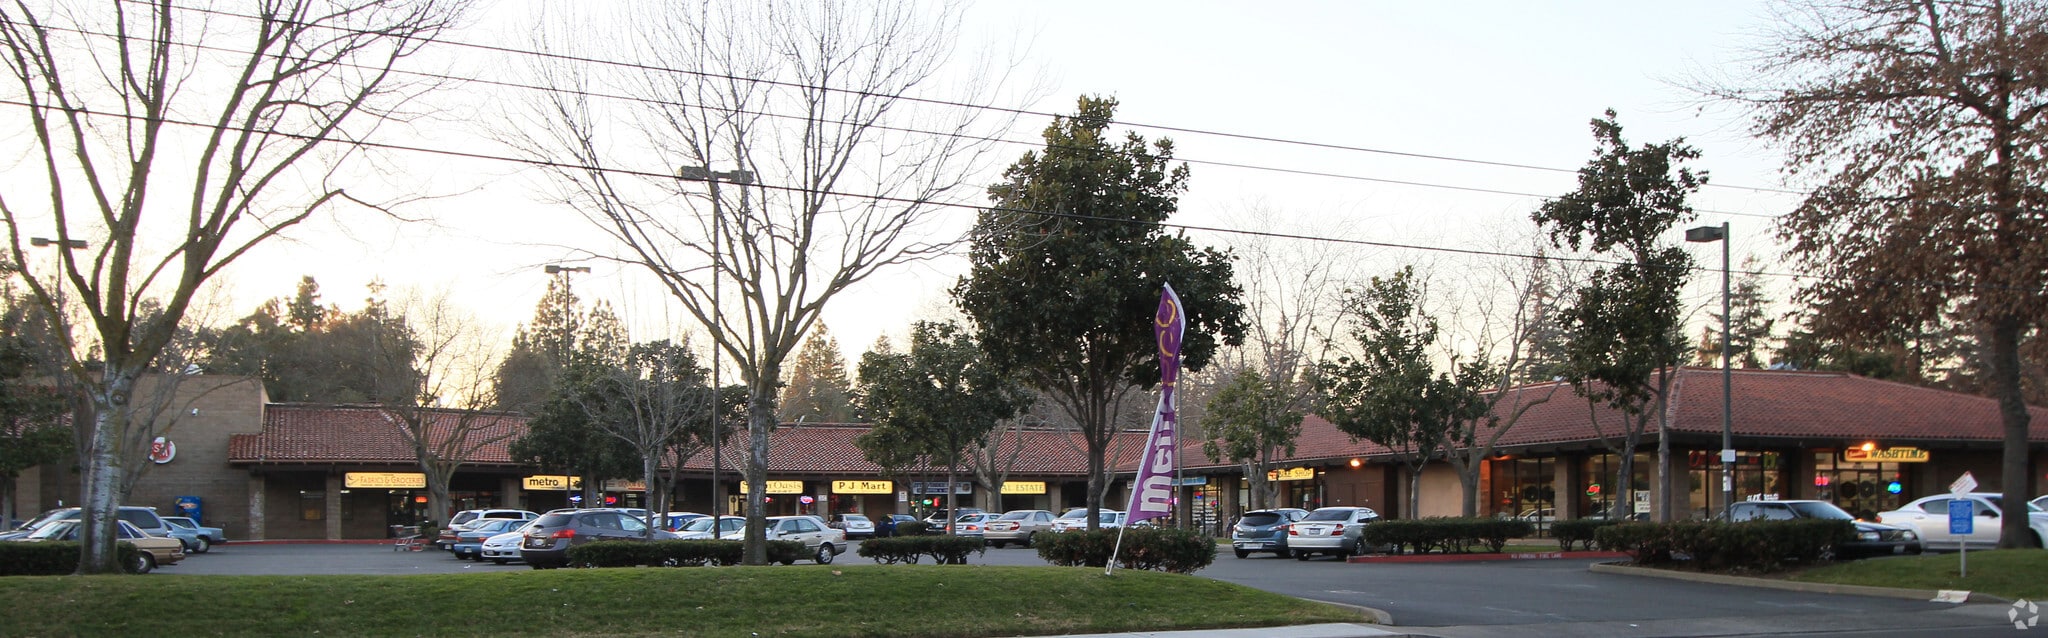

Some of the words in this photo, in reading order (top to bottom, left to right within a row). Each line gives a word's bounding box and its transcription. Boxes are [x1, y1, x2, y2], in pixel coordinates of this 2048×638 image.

[1871, 449, 1926, 459] WASHTIME
[360, 476, 383, 484] FABRICS
[391, 476, 424, 484] GROCERIES
[529, 477, 559, 487] metro
[773, 481, 802, 490] Oasis
[861, 482, 887, 490] Mart
[1016, 484, 1043, 492] ESTATE
